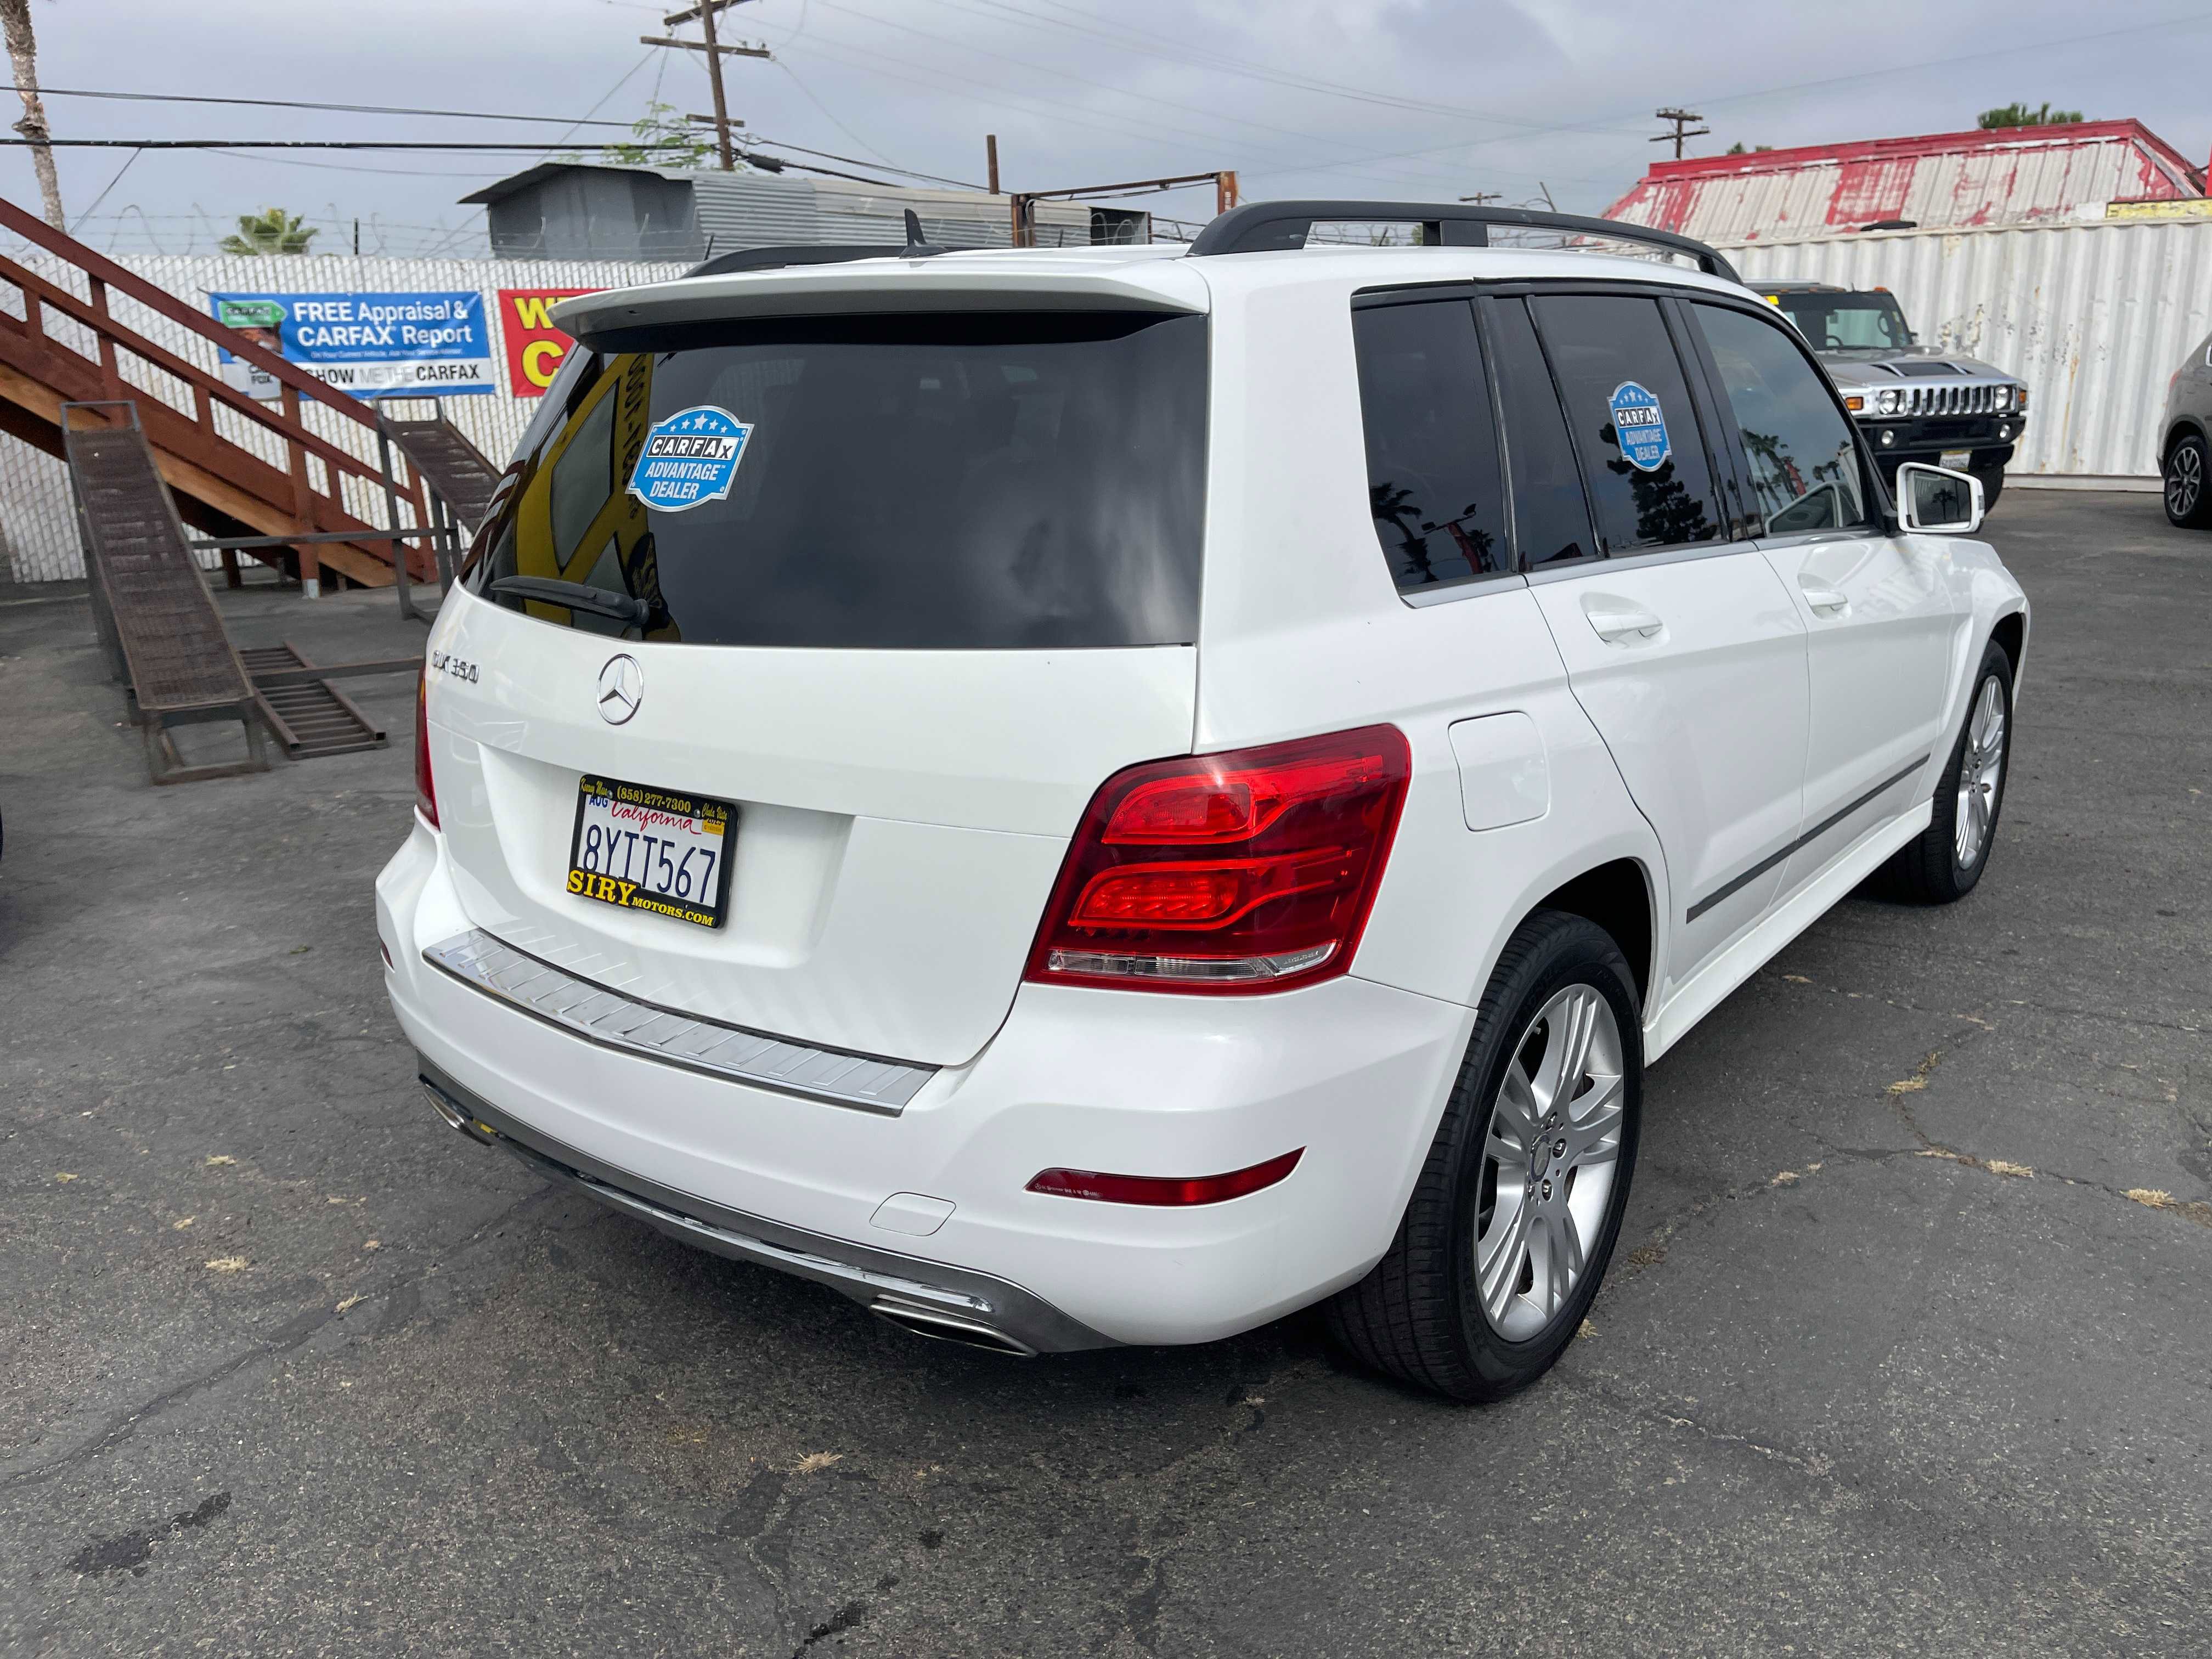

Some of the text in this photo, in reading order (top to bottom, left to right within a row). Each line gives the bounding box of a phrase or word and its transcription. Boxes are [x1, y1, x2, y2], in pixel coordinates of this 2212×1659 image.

[293, 300, 469, 325] FREE Appraisal &
[297, 325, 473, 348] CARFAX Report
[416, 364, 480, 381] CARFAX
[1617, 409, 1660, 426] CARFAX
[650, 438, 733, 459] CARFAX
[645, 462, 723, 481] ADVANTAGE
[650, 481, 700, 500] DEALER
[589, 796, 608, 808] AUG
[611, 800, 702, 835] California
[567, 870, 636, 906] SIRY
